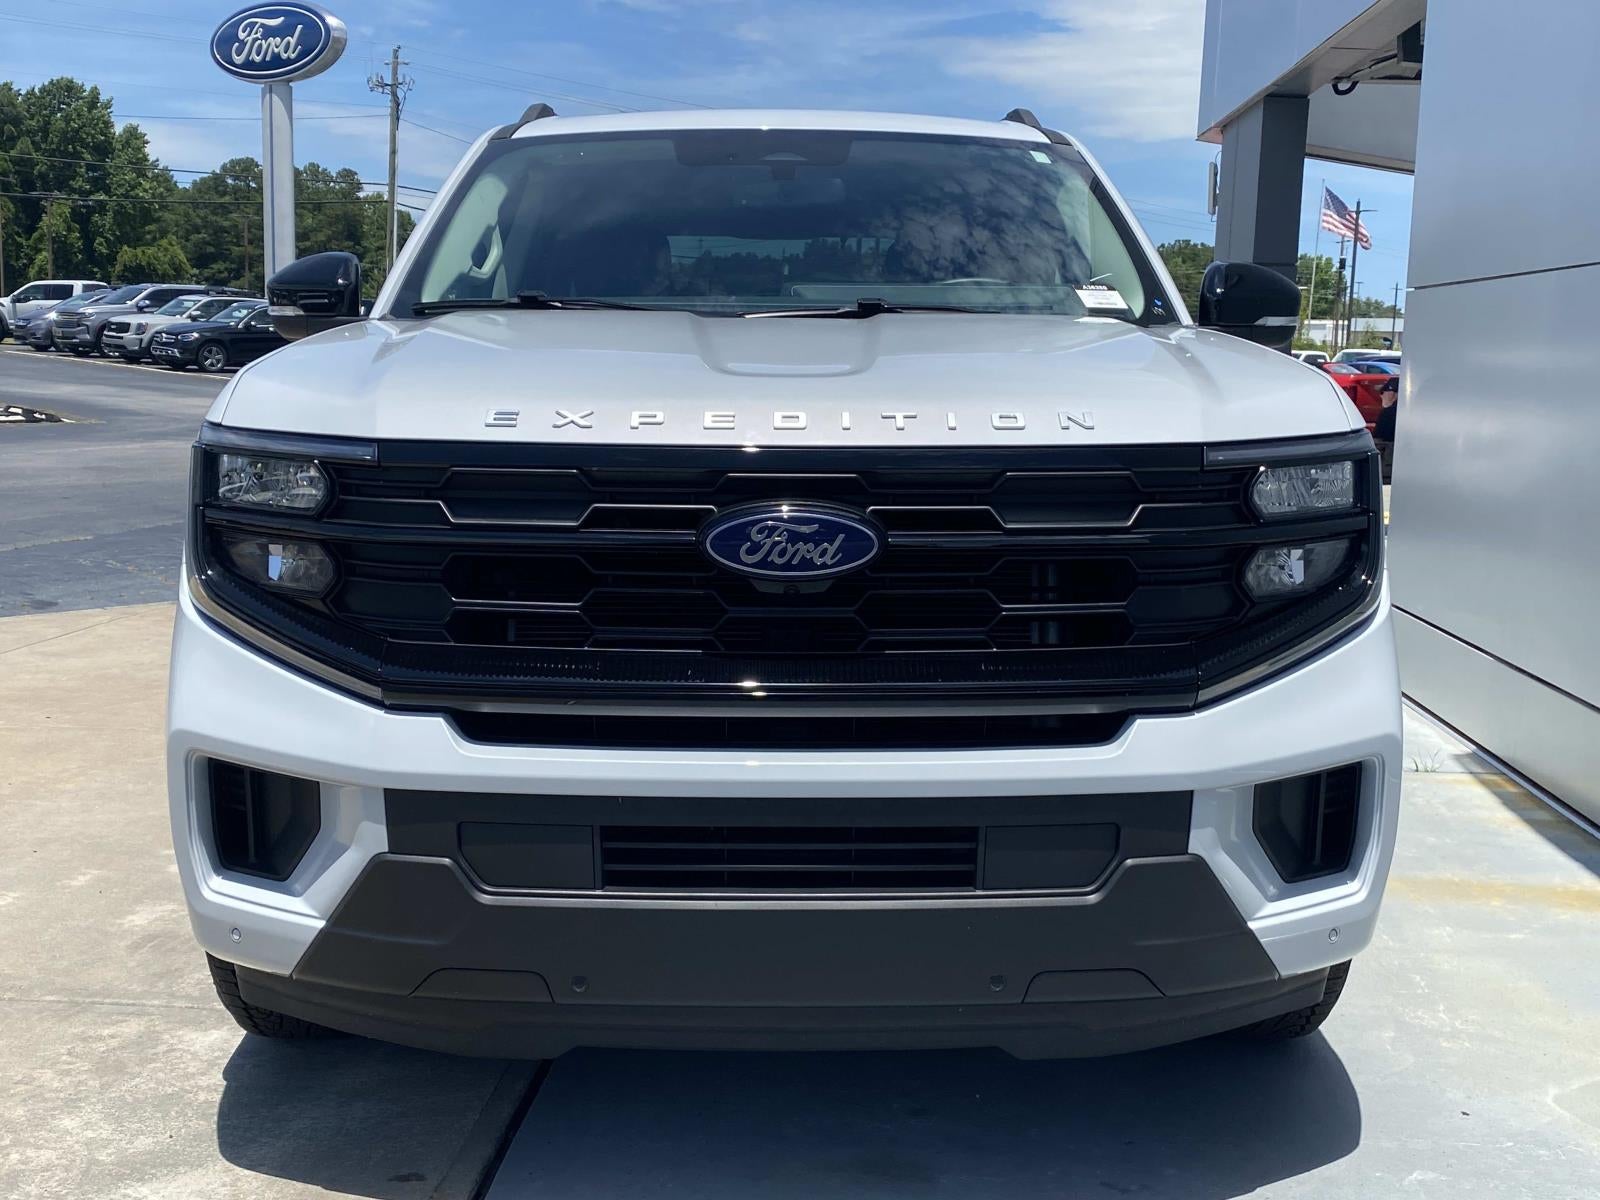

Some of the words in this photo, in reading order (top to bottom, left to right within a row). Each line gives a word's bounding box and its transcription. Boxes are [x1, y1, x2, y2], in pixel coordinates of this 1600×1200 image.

[231, 17, 303, 64] Ford
[484, 409, 1095, 430] EXPEDITION
[739, 521, 845, 565] Ford
